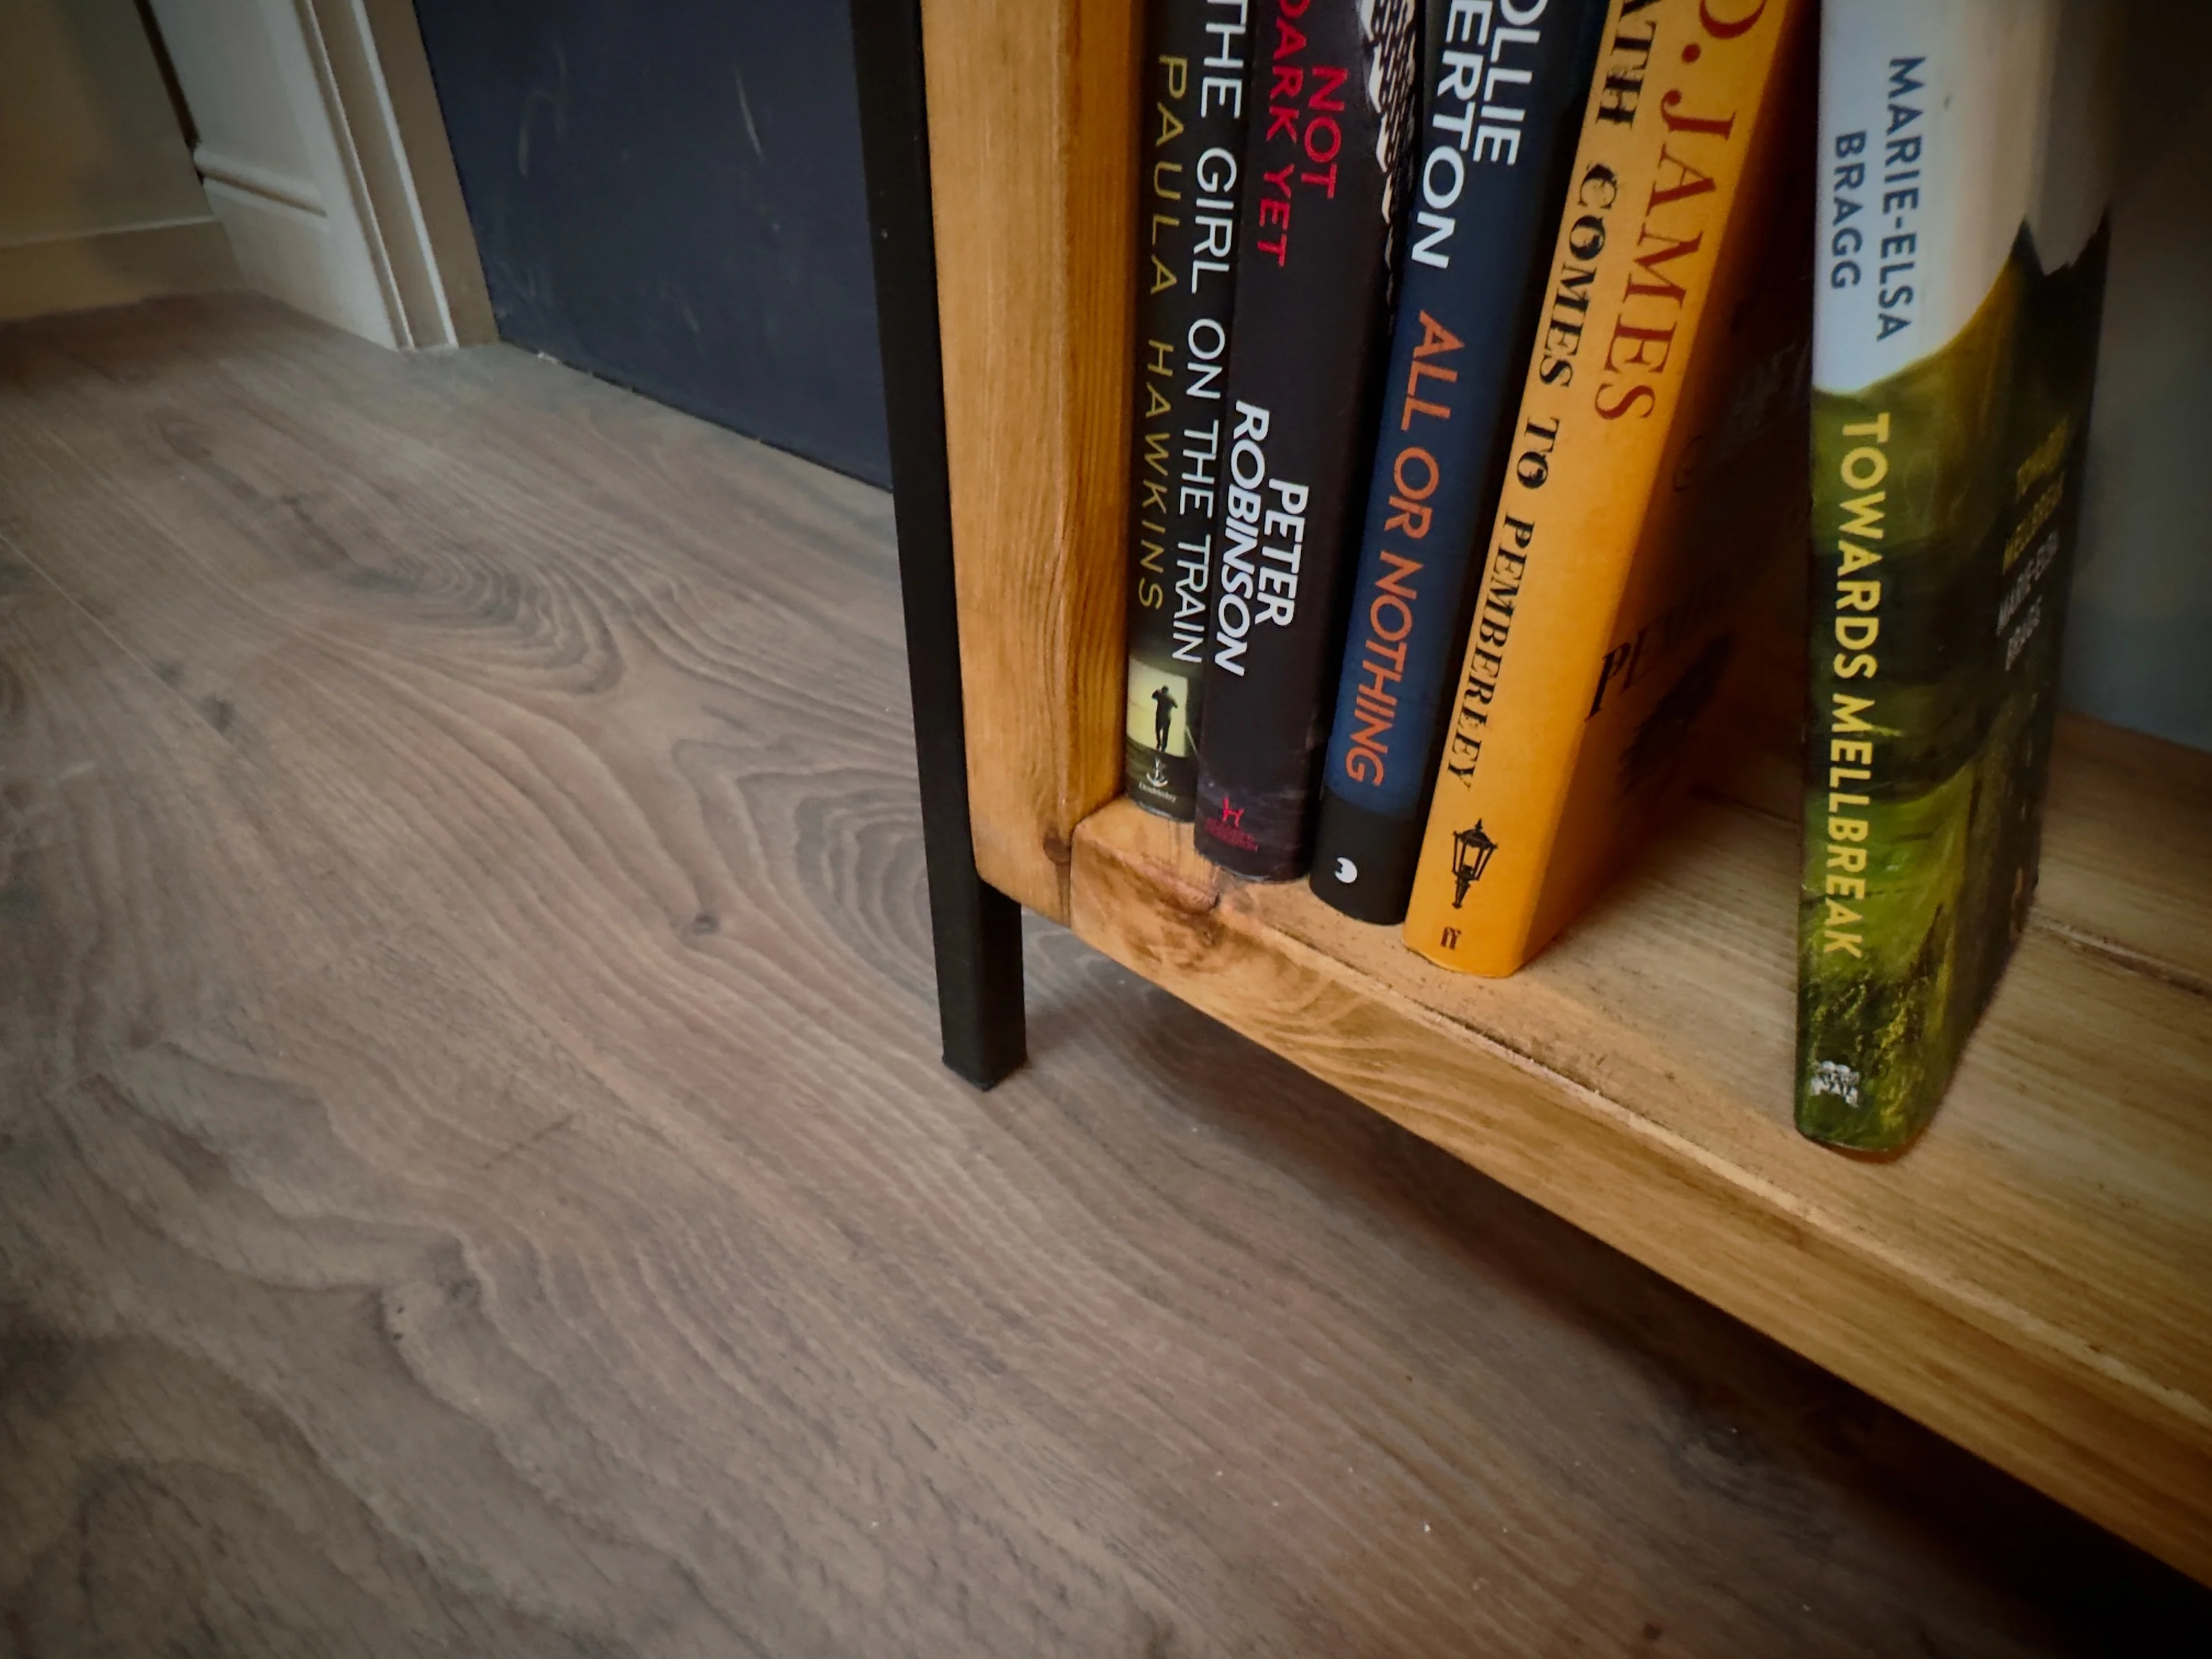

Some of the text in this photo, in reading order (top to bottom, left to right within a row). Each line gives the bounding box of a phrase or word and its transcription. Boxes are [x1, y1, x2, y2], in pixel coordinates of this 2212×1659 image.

[1191, 147, 1239, 294] GIRL
[1257, 0, 1312, 268] DARK YET
[1301, 68, 1349, 199] NOT
[1830, 130, 1867, 289] BRAGG
[1876, 55, 1927, 343] MARIE-ELSA
[1139, 54, 1189, 611] PAULA HAWKINS
[1185, 318, 1227, 400] ON
[1538, 162, 1619, 388] COMES
[1594, 89, 1739, 421] JAMES
[1180, 419, 1219, 520] THE
[1215, 400, 1271, 677] ROBINSON
[1255, 477, 1309, 627] PETER
[1345, 309, 1466, 787] ALL OR NOTHING
[1516, 416, 1561, 491] TO
[1172, 536, 1211, 664] TRAIN
[1447, 510, 1537, 791] PEMBERLEY
[1823, 413, 1891, 959] TOWARDS MELLBREAK
